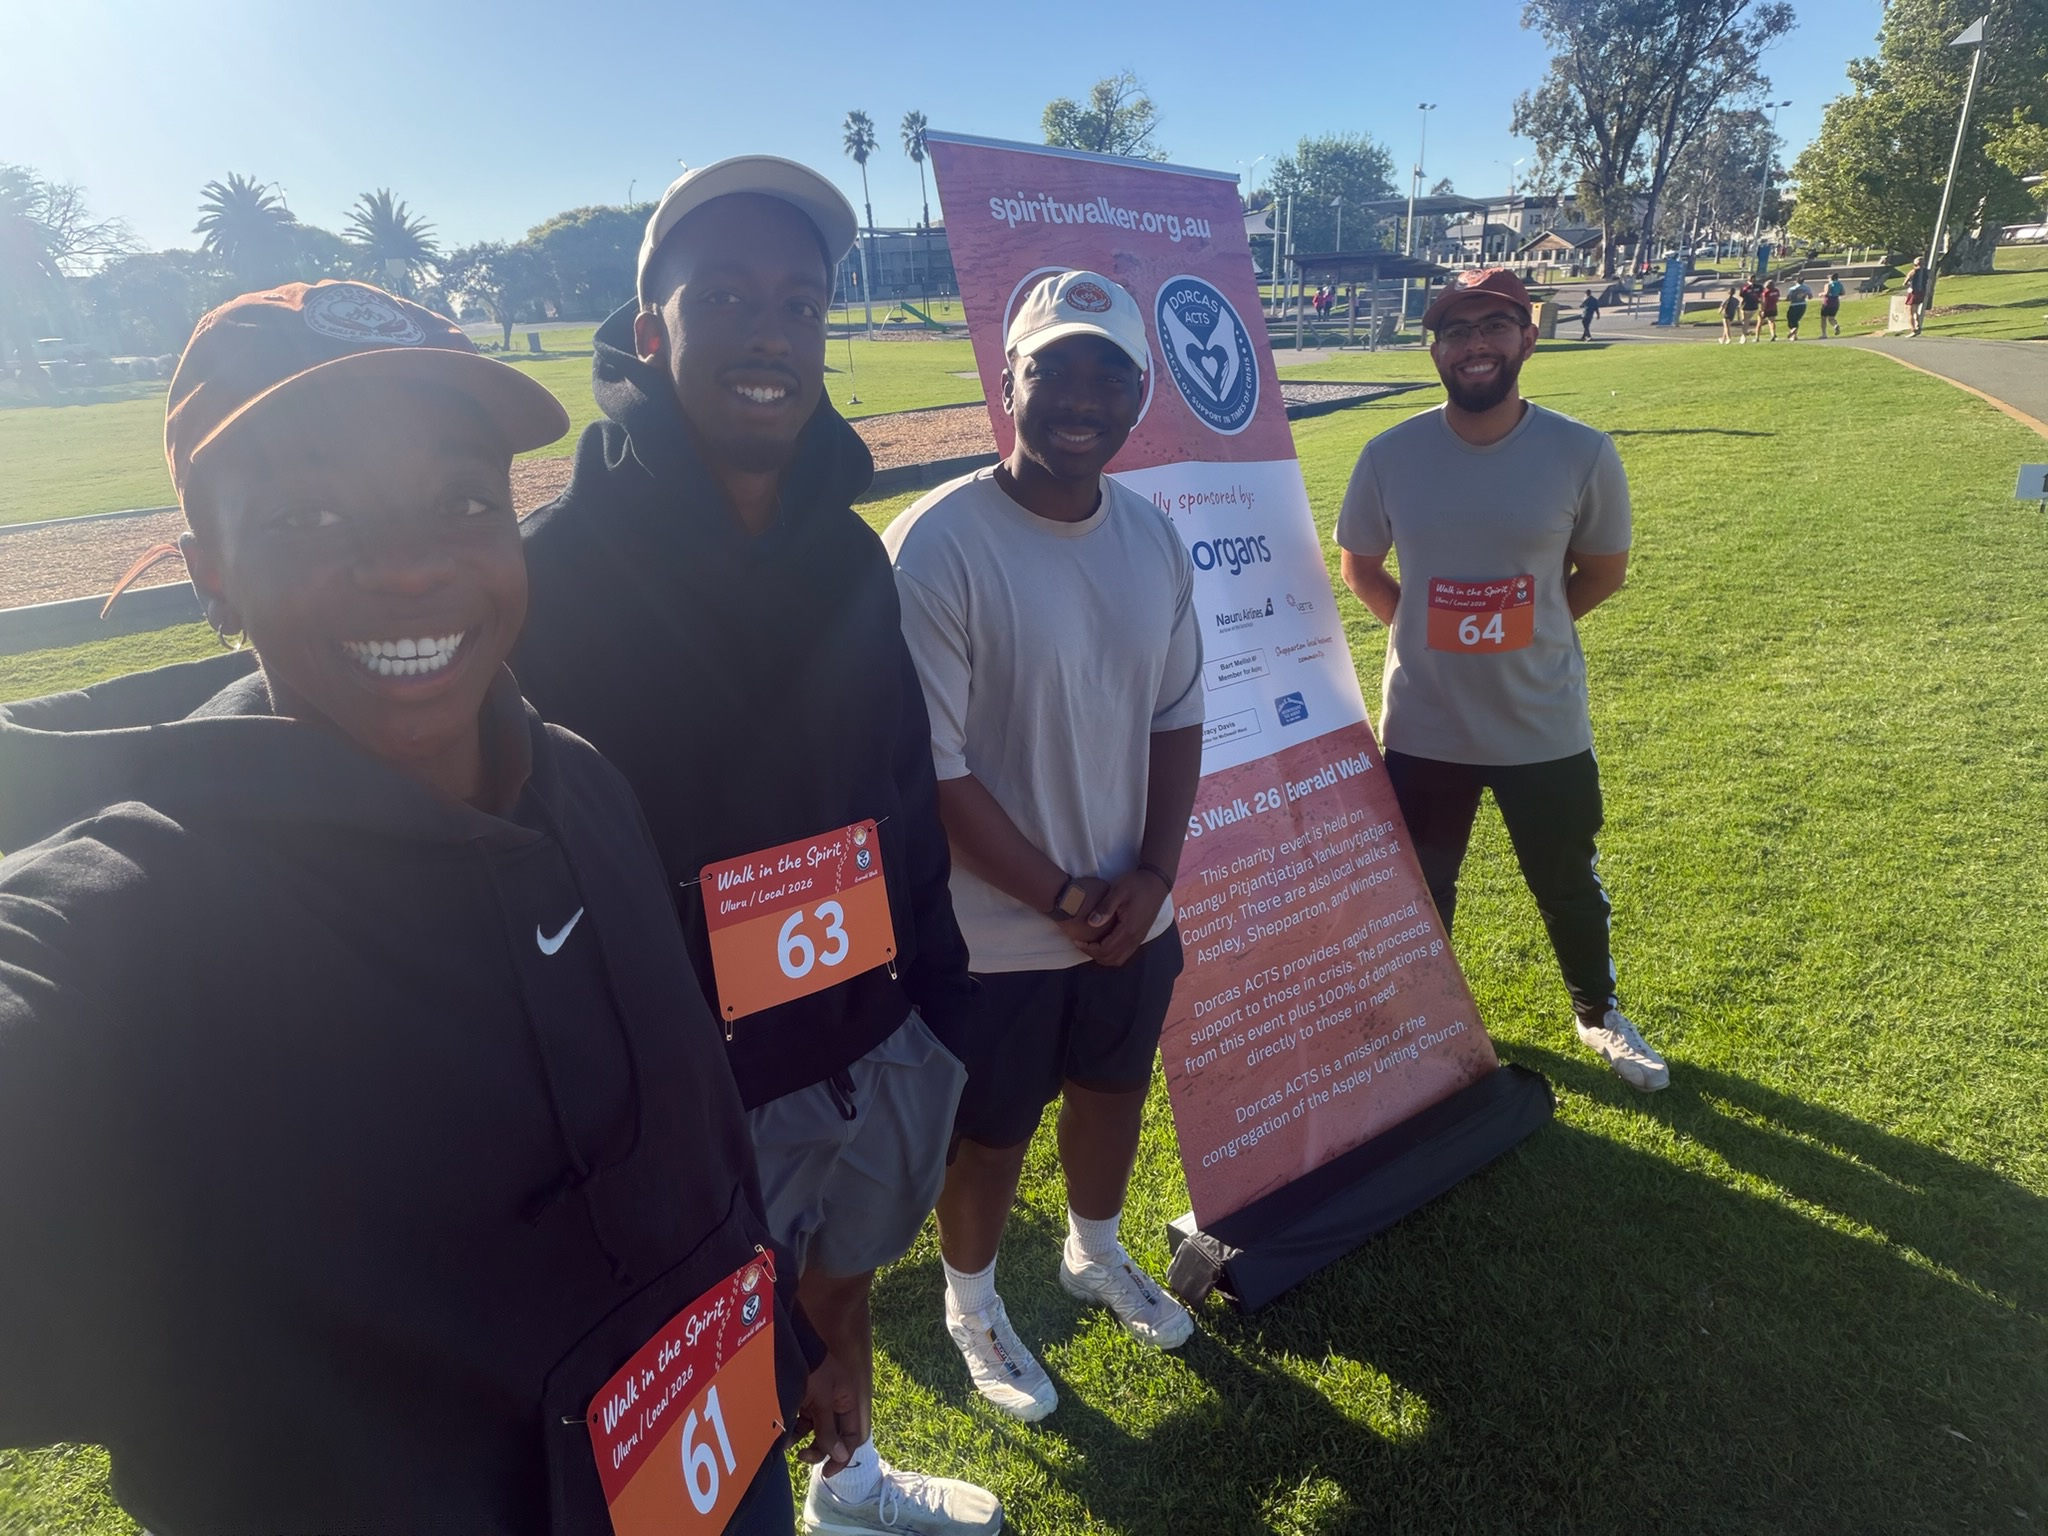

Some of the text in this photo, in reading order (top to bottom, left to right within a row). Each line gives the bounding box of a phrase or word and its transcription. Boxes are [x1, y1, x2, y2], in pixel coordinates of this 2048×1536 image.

[989, 191, 1212, 242] spiritwalker.org.au
[1169, 290, 1219, 314] DORCAS
[1185, 311, 1210, 326] ACTS
[1168, 352, 1182, 380] ACTS
[1182, 382, 1192, 396] OF
[1191, 396, 1222, 423] SUPPORT
[1223, 415, 1230, 424] IN
[1231, 402, 1247, 422] TIMES
[1244, 390, 1251, 403] OF
[1178, 485, 1237, 514] sponsored
[1238, 485, 1255, 510] by:
[1192, 535, 1272, 576] organs
[1436, 584, 1508, 598] Walk in the Spirit
[1216, 608, 1264, 626] Nauru Airlines
[1458, 613, 1505, 646] 64
[1218, 670, 1242, 682] Member
[1220, 662, 1234, 670] Bart
[1202, 722, 1236, 736] racy Davis
[1202, 798, 1252, 831] Walk
[1254, 788, 1282, 814] 26
[1285, 764, 1338, 802] Everald
[1336, 752, 1374, 780] Walk
[717, 841, 842, 892] Walk in the Spirit
[1178, 820, 1394, 923] Anangu Pitjantjatjara Yankunytjatjara
[1200, 808, 1364, 886] This charity event is held on
[720, 898, 748, 915] Uluru
[758, 884, 786, 904] Local
[788, 878, 814, 894] 2026
[1182, 840, 1401, 946] Country. There are also local walks at
[1197, 866, 1398, 966] Aspley, Shepparton, and Windsor.
[777, 900, 850, 980] 63
[1194, 901, 1420, 1018] Dorcas ACTS provides rapid financial
[1184, 938, 1444, 1074] from this event plus 100% of donations go
[1190, 921, 1432, 1046] support to those in crisis. The proceeds
[1246, 981, 1399, 1067] directly to those in need.
[1202, 1020, 1469, 1168] congregation of the Aspley Uniting Church.
[1236, 1014, 1426, 1124] Dorcas ACTS is a mission of the
[602, 1296, 726, 1435] Walk in the Spirit
[612, 1432, 639, 1470] Uluru
[646, 1387, 670, 1430] Local
[670, 1364, 694, 1398] 2026
[681, 1384, 737, 1515] 61
